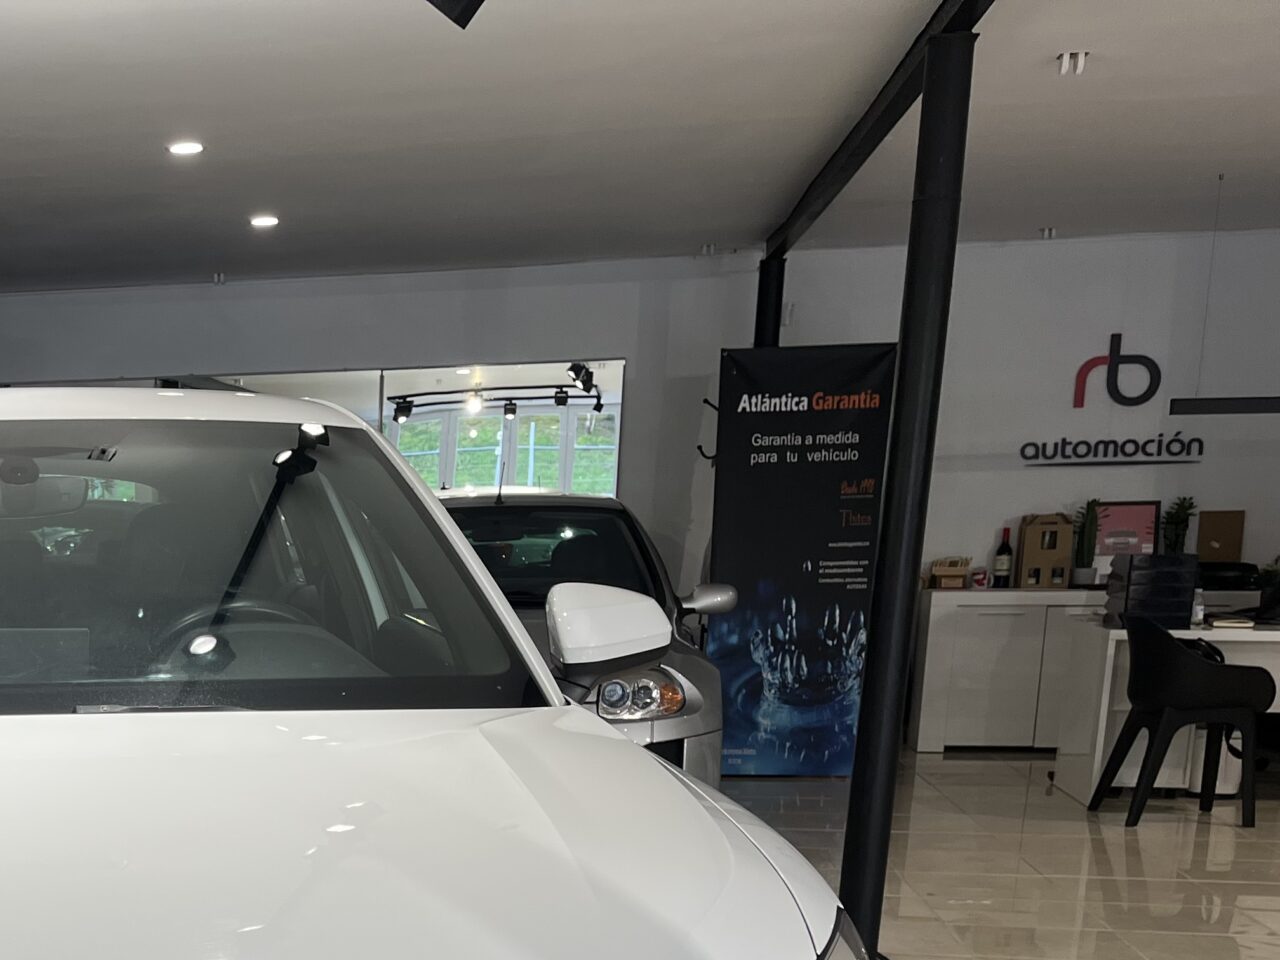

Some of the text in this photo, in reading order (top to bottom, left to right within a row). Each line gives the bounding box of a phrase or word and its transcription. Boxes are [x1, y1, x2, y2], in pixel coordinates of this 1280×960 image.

[1073, 333, 1161, 408] rb
[737, 393, 808, 413] Atlántica
[805, 435, 813, 446] a
[816, 431, 860, 445] medida
[1020, 431, 1204, 460] automoción
[750, 452, 778, 467] para
[786, 451, 798, 462] tu
